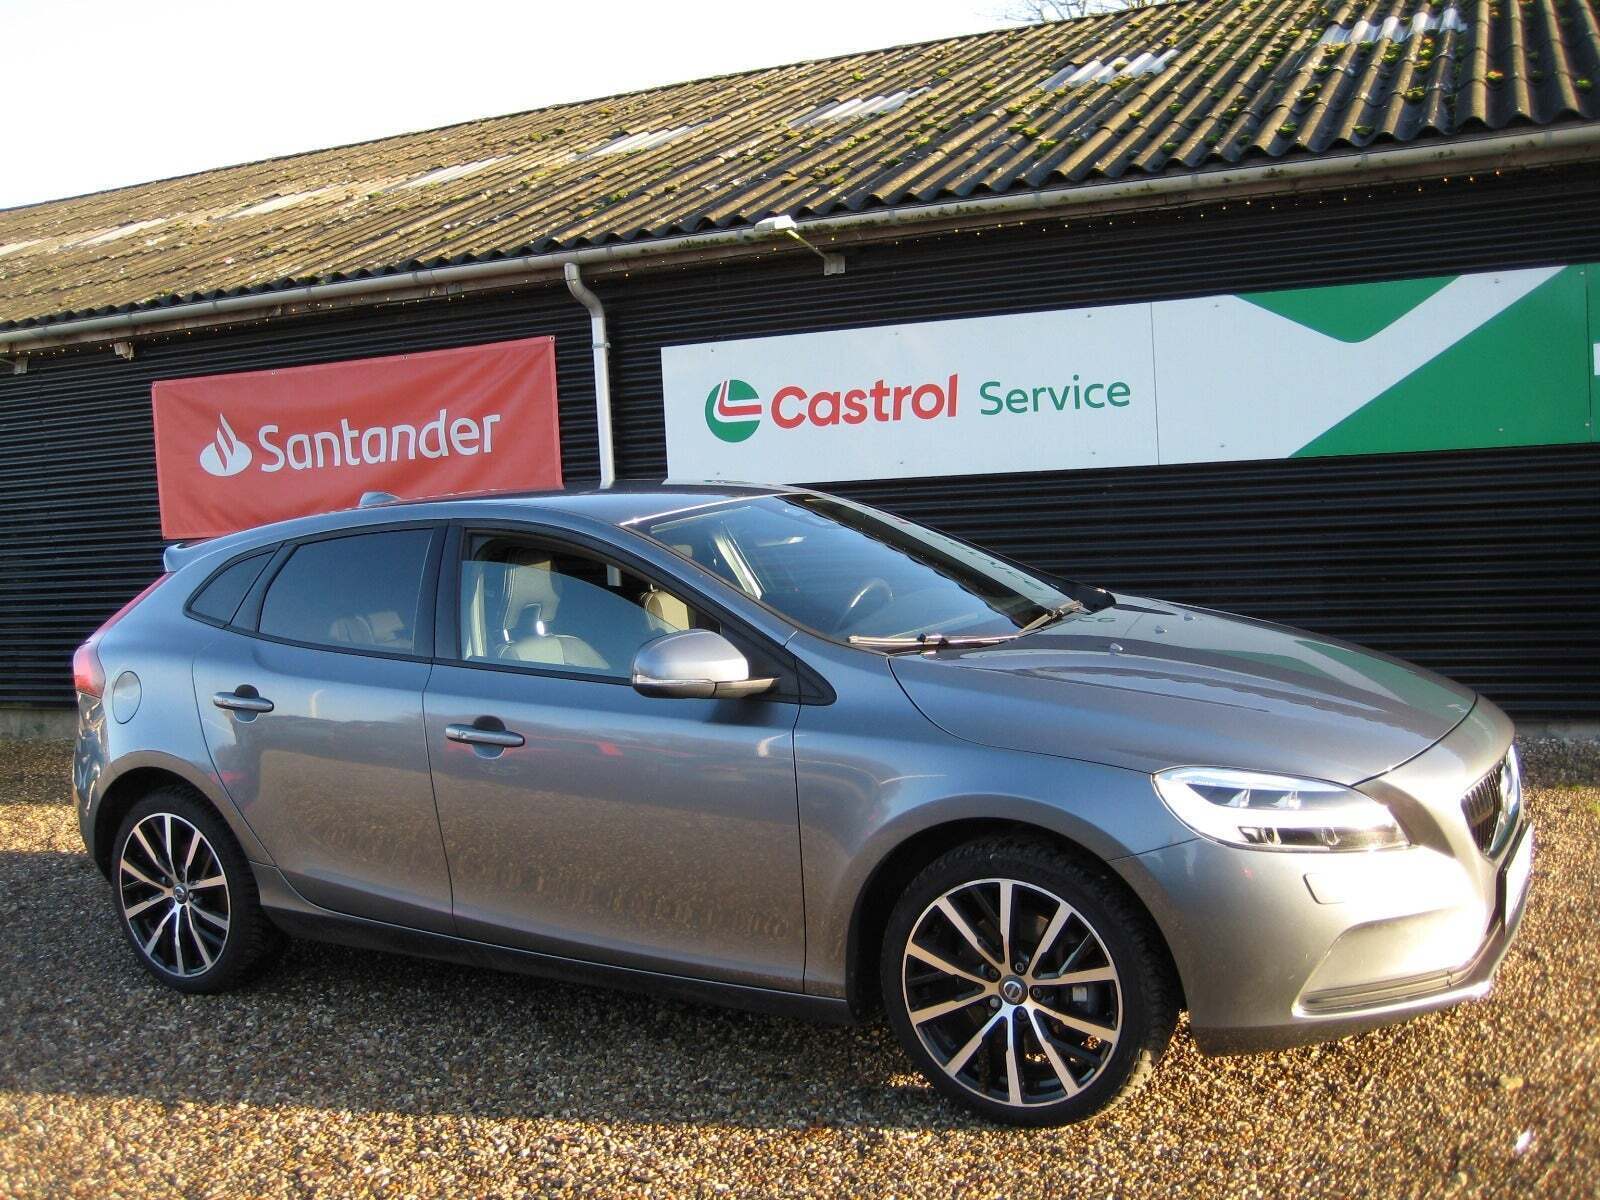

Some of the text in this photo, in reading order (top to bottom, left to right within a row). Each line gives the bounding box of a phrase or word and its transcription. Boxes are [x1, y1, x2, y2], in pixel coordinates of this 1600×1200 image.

[771, 374, 1131, 429] Castrol Service
[258, 408, 501, 473] Santander
